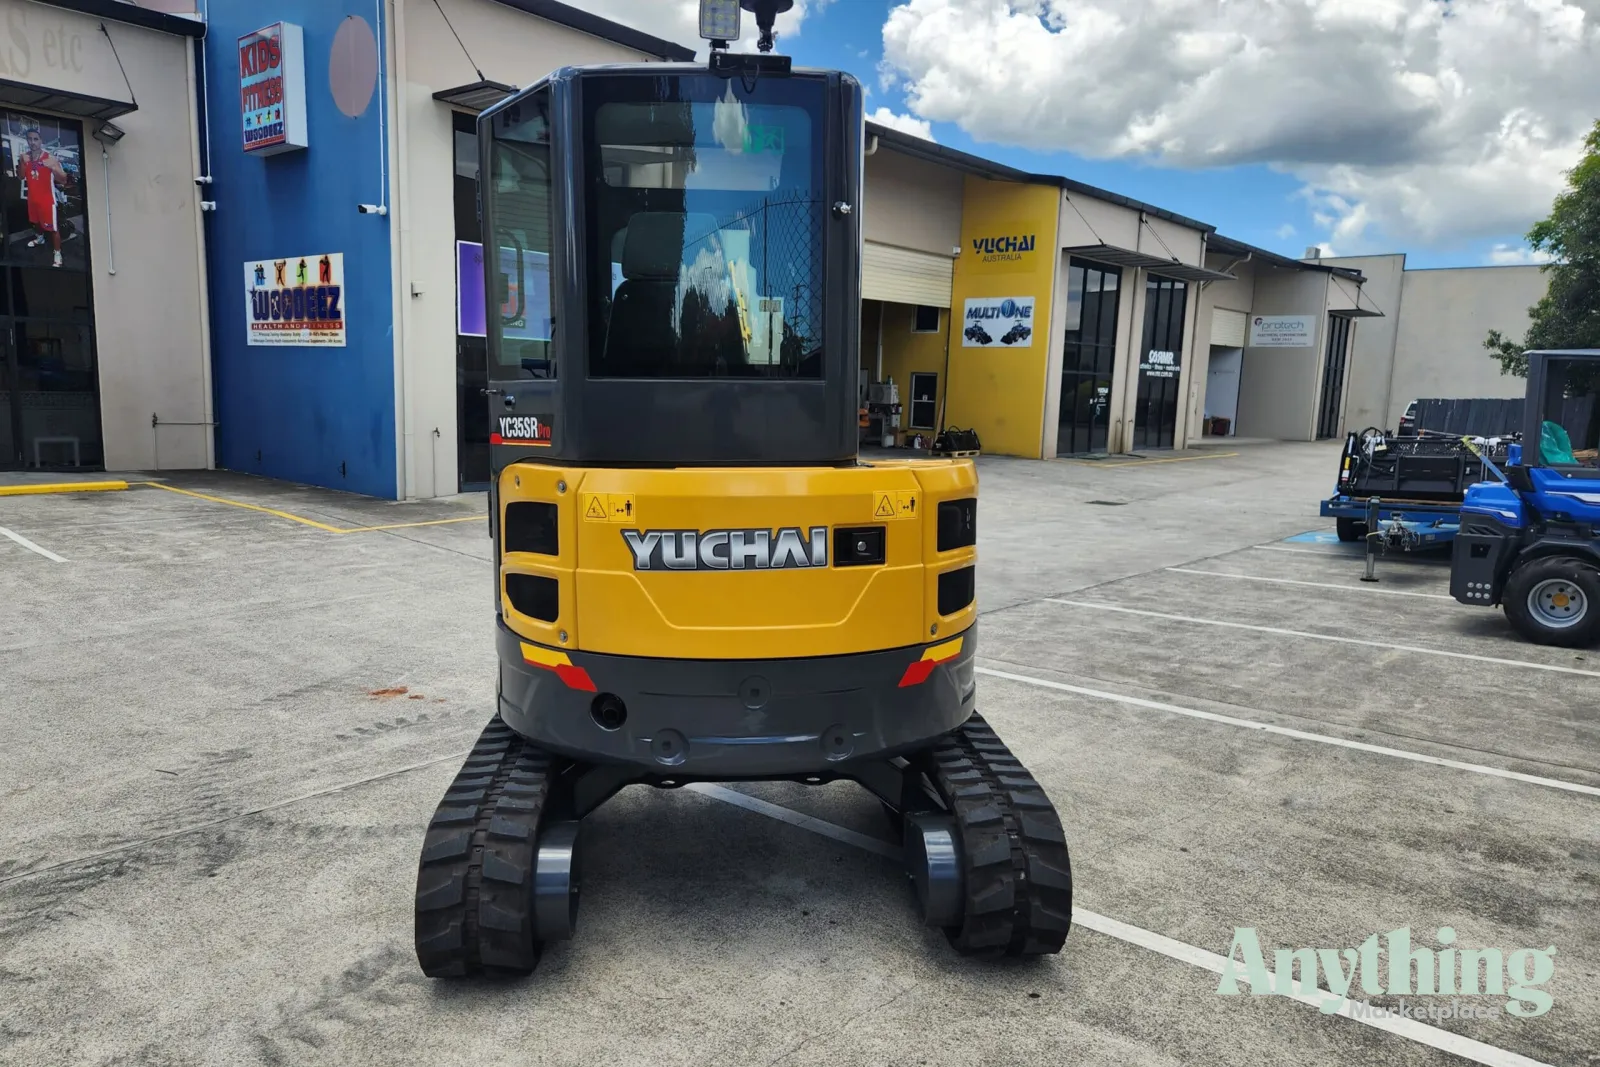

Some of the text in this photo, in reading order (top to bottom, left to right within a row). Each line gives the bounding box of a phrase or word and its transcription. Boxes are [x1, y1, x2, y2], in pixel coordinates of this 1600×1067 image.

[43, 25, 83, 74] etc
[240, 35, 280, 79] KIDS
[241, 76, 283, 113] FITNESS
[244, 121, 284, 142] WOODEEZ
[973, 235, 1035, 254] YUCHAI
[982, 254, 1022, 262] AUSTRALIA
[250, 285, 341, 320] WOODEEZ
[499, 416, 538, 438] YC35SR
[622, 527, 828, 570] YUCHAI
